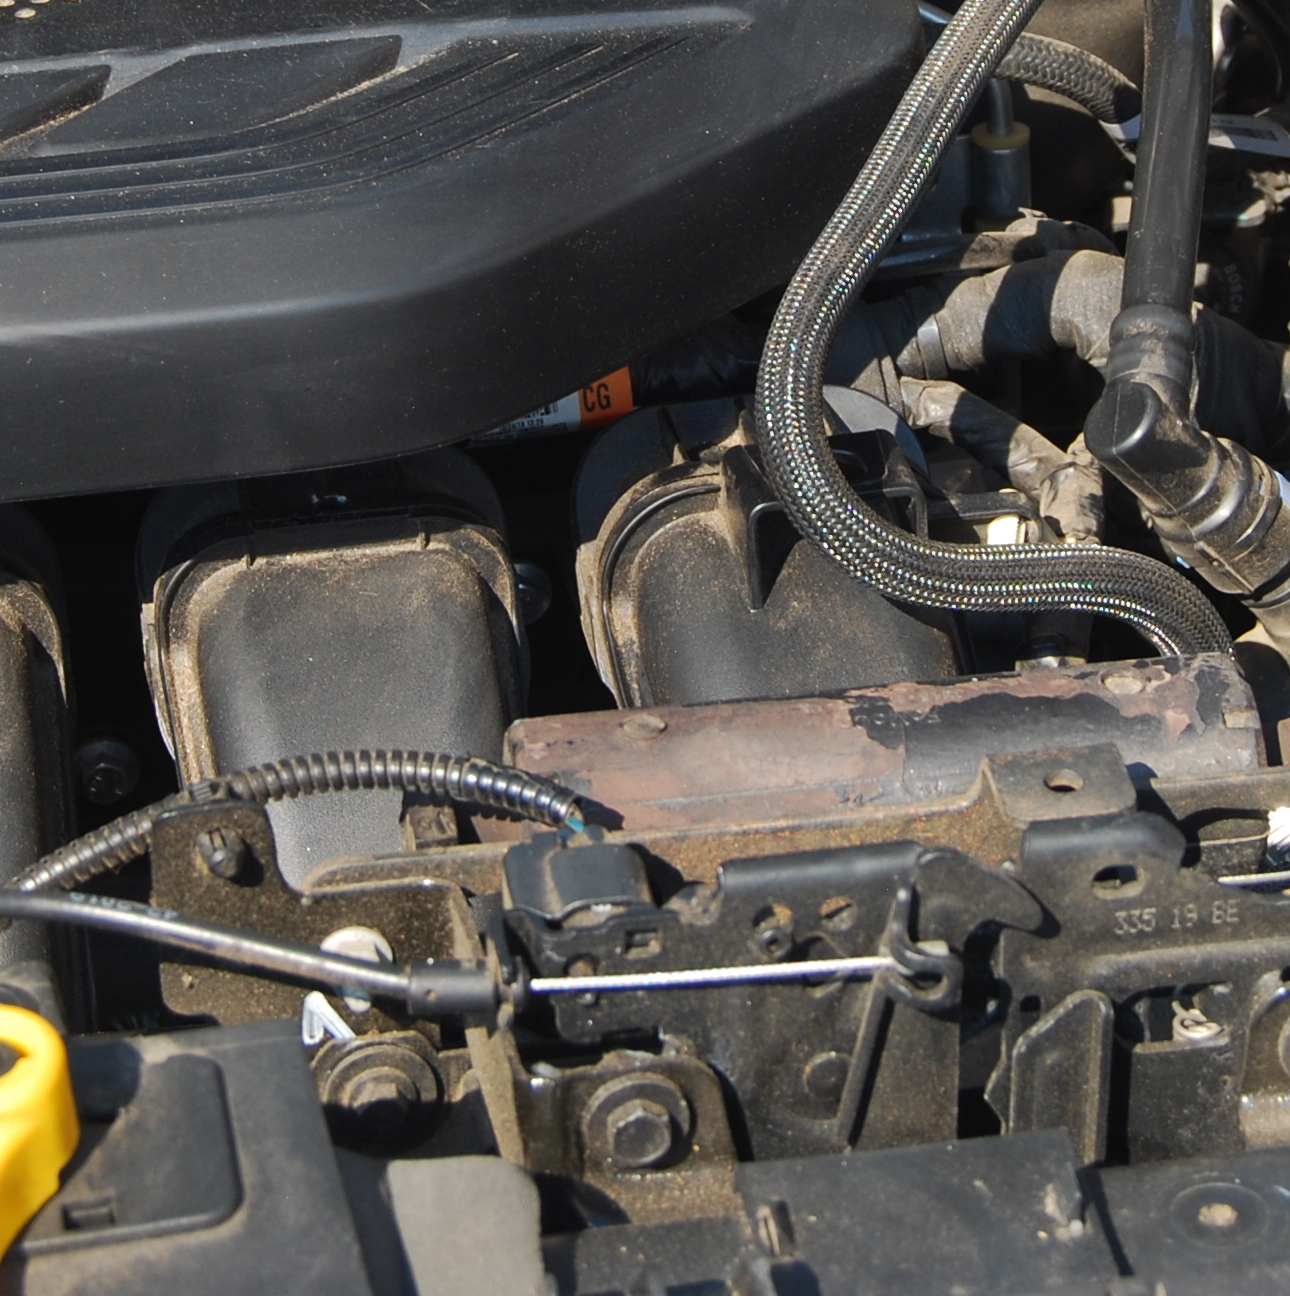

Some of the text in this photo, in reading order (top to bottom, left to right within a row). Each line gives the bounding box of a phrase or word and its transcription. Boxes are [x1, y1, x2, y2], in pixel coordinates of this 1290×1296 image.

[1224, 263, 1243, 313] BOSCH
[582, 382, 612, 413] CG
[1113, 907, 1157, 935] 335
[1171, 903, 1198, 929] 19
